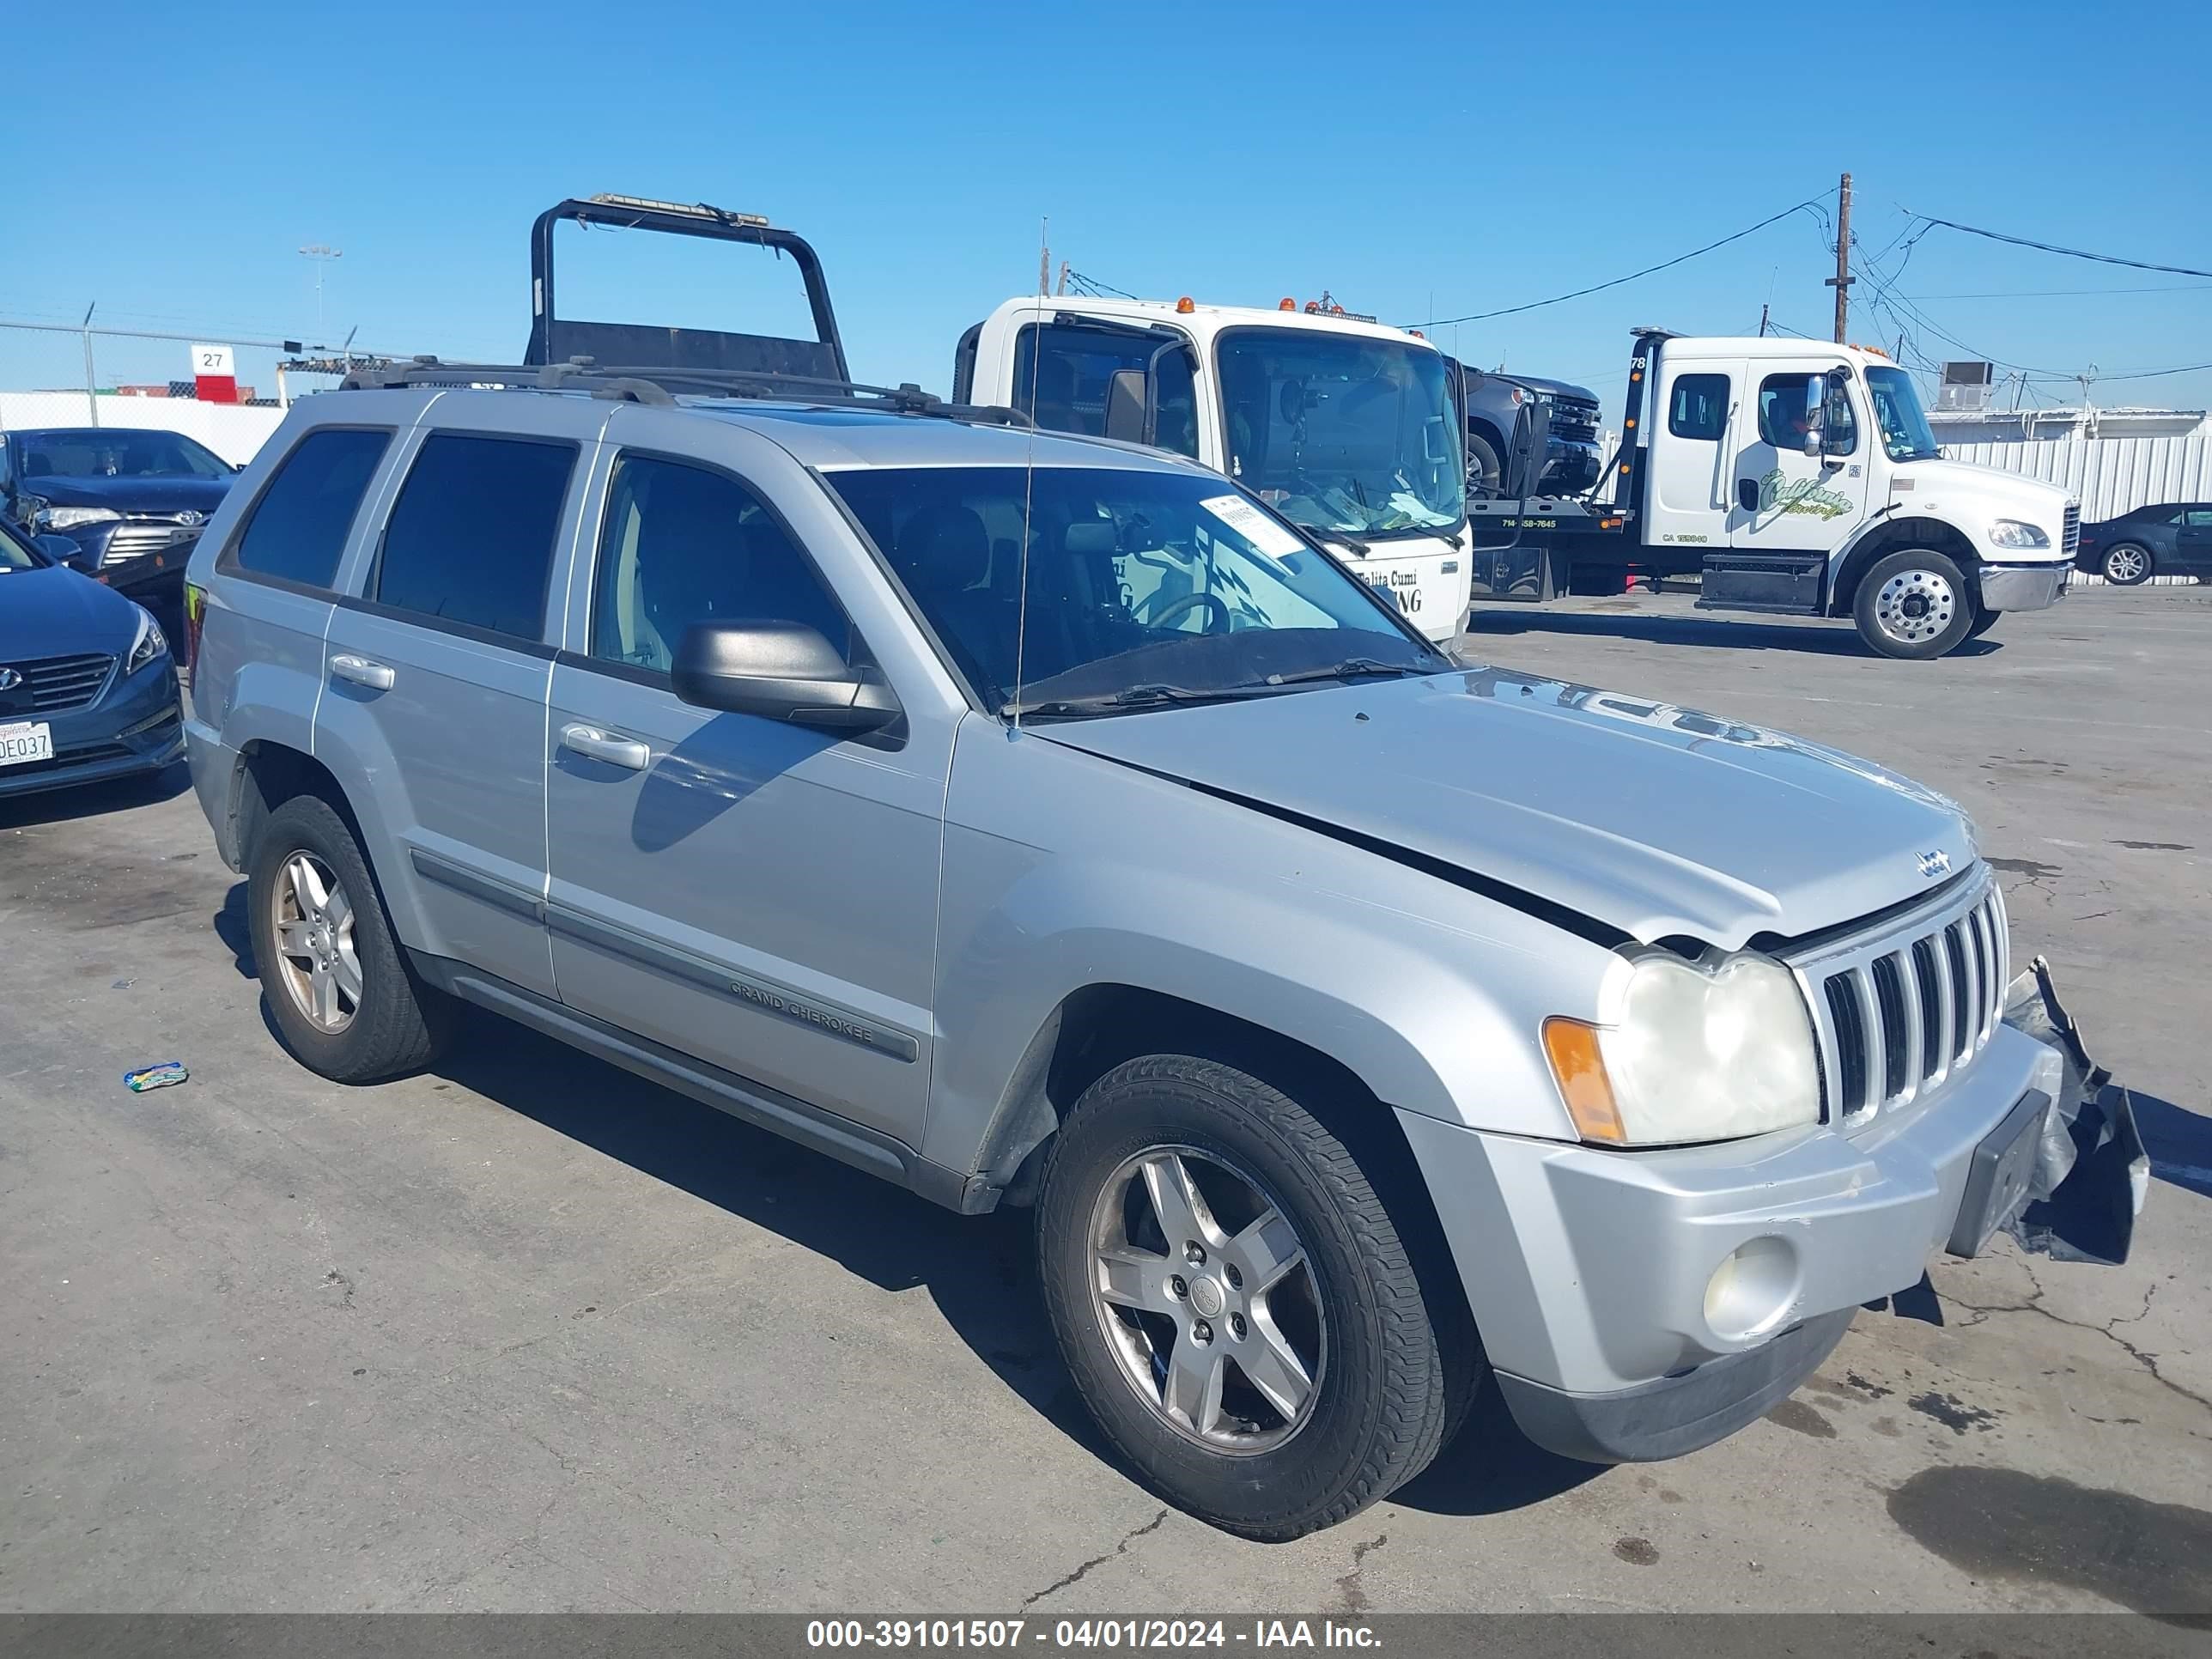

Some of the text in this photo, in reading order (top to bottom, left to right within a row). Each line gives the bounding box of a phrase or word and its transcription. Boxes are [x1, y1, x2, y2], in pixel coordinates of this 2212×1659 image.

[204, 354, 222, 367] 27
[1632, 357, 1646, 369] 78
[1850, 467, 1860, 477] 26
[1760, 474, 1855, 514] California
[1502, 519, 1557, 528] 714-58-7645
[1662, 533, 1675, 542] CA
[1391, 568, 1417, 586] Cumi
[1395, 588, 1422, 613] NG
[1914, 849, 1952, 878] Jeep
[730, 981, 873, 1042] GRAND CHEROKEE
[1194, 1285, 1217, 1310] Jeep
